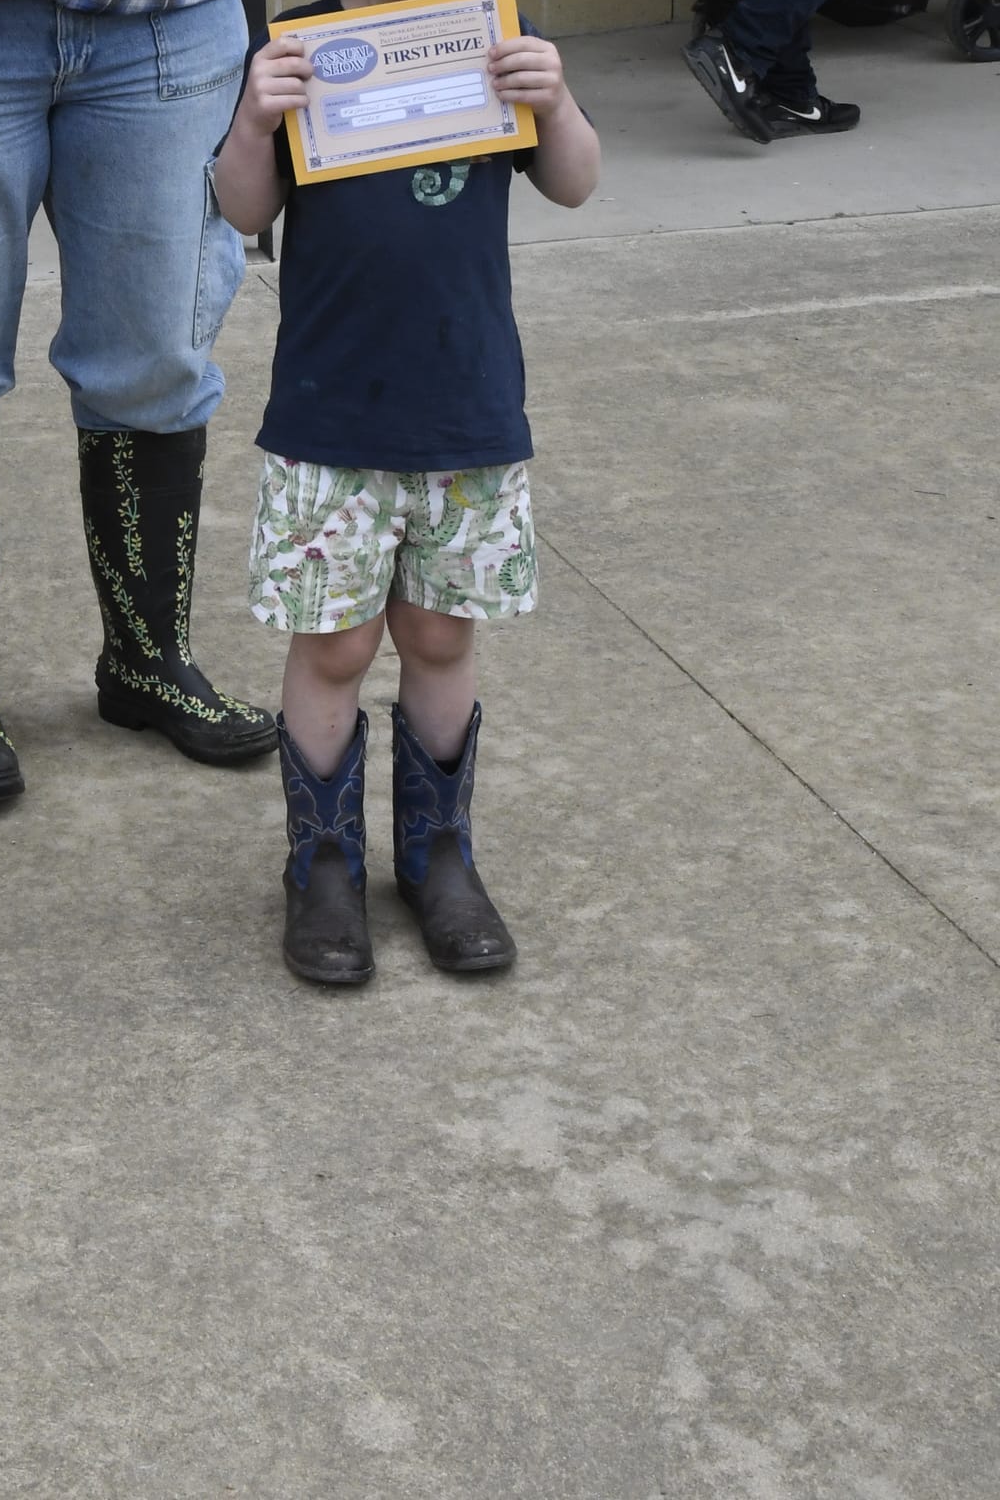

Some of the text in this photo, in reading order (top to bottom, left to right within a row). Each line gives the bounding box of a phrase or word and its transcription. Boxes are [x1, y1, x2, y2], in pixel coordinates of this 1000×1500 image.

[313, 44, 374, 67] ANNUAL
[383, 36, 485, 65] FIRST PRIZE
[322, 59, 367, 78] SHOW
